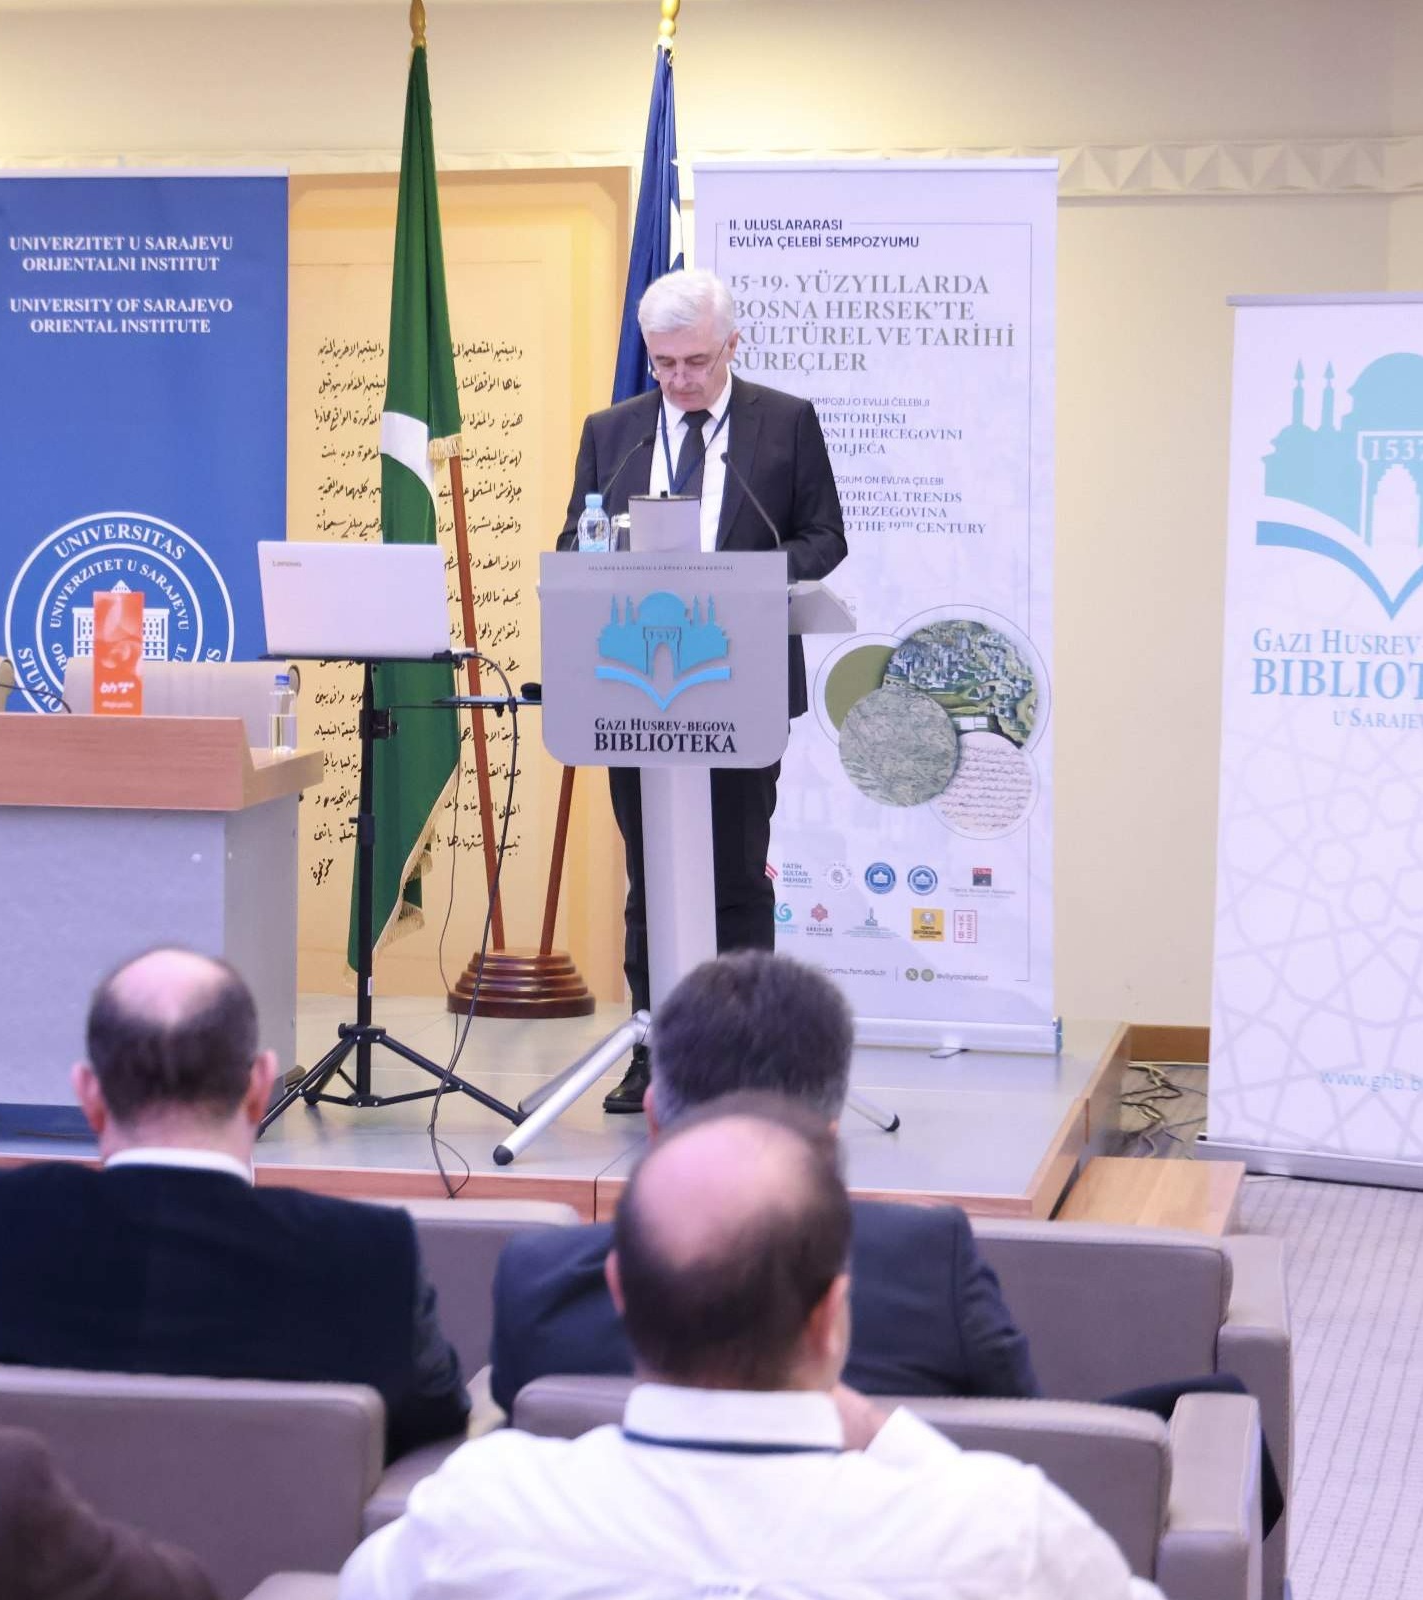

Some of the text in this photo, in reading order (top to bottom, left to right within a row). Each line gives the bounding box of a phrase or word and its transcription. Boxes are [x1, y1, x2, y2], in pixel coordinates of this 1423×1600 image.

[729, 219, 843, 231] II. ULUSLARARASI
[9, 236, 234, 251] UNIVERZITET U SARAJEVU
[729, 234, 920, 250] EVLİYA ÇELEBİ SEMPOZYUMU
[22, 256, 220, 272] ORIJENTALNI INSTITUT
[729, 269, 991, 295] 15-19. YÜZYILLARDA
[9, 298, 233, 313] UNIVERSITY OF SARAJEVO
[734, 300, 818, 320] BOSNA
[30, 318, 211, 334] ORIENTAL INSTITUTE
[876, 326, 912, 347] VE
[911, 323, 1015, 348] TARİHİ
[728, 347, 868, 375] SÜREÇLER
[817, 412, 907, 427] HISTORIJSKI
[824, 428, 846, 439] SNI
[858, 428, 963, 441] HERCEGOVINI
[826, 441, 887, 457] TOLJEĆA
[834, 476, 862, 485] OSIUM
[864, 476, 879, 485] ON
[838, 490, 963, 504] TORICAL TRENDS
[841, 506, 948, 518] HERZEGOVINA
[854, 521, 887, 532] THE
[916, 522, 987, 534] CENTURY
[53, 523, 186, 561] UNIVERSITAS
[49, 558, 190, 631] UNIVERZITET U SARAJEVU
[1321, 629, 1423, 656] HUSREV
[18, 647, 64, 713] STUDIO
[594, 732, 738, 753] BIBLIOTEKA
